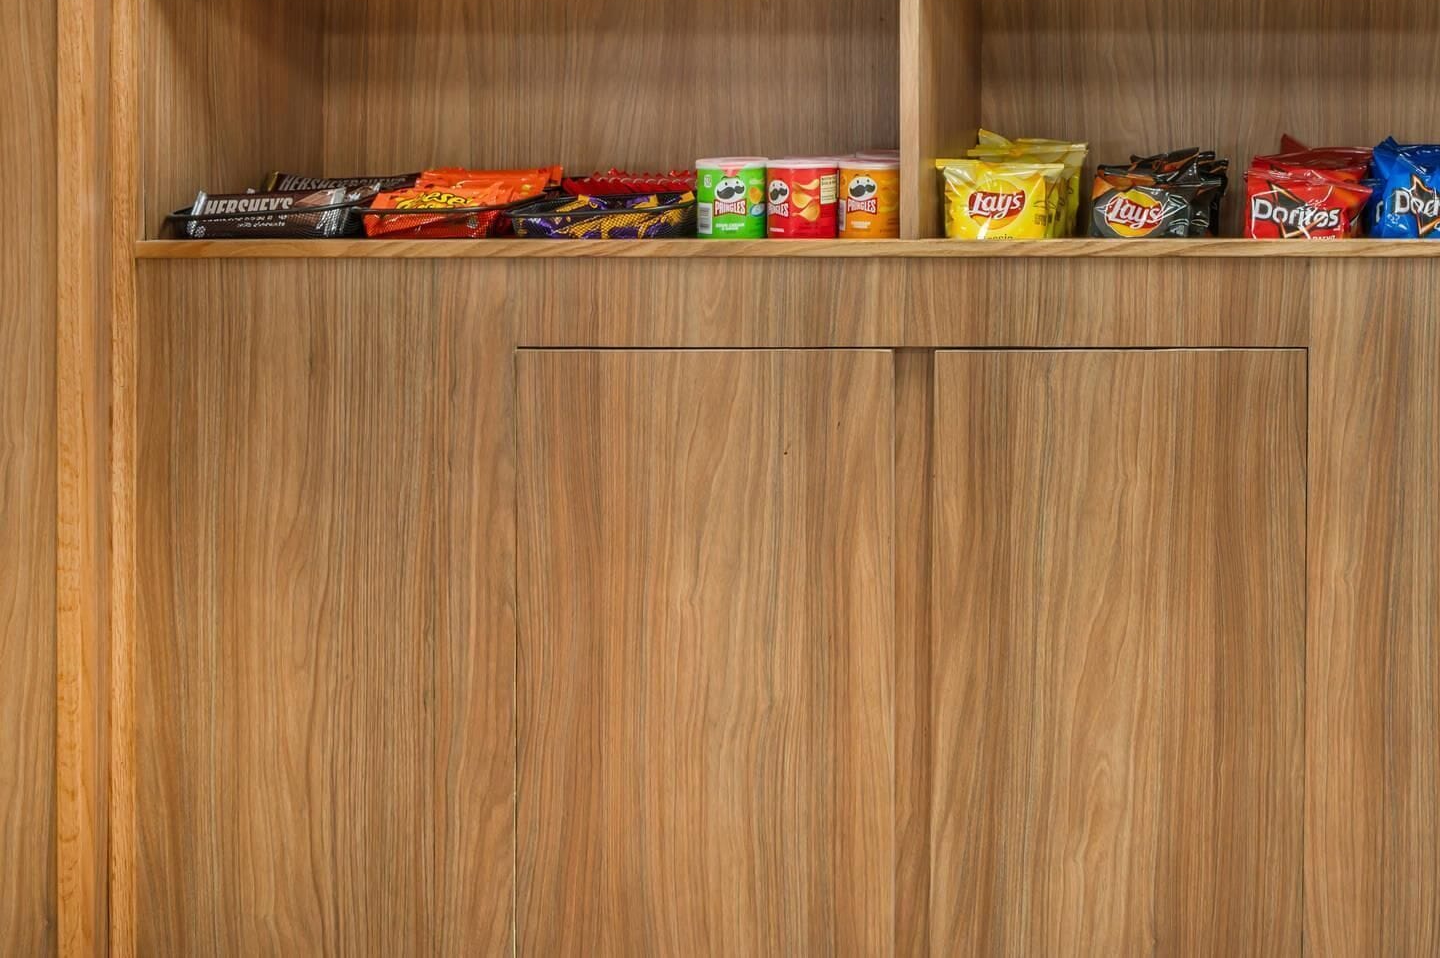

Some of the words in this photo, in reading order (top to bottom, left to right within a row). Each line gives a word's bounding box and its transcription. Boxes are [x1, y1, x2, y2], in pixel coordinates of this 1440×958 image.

[204, 197, 293, 215] HERSHEY'S
[714, 200, 747, 215] PRINGLES
[847, 199, 877, 215] PRINGLES
[968, 192, 1023, 220] Lay's
[1109, 196, 1163, 229] Lay's
[1253, 197, 1340, 228] Doritos
